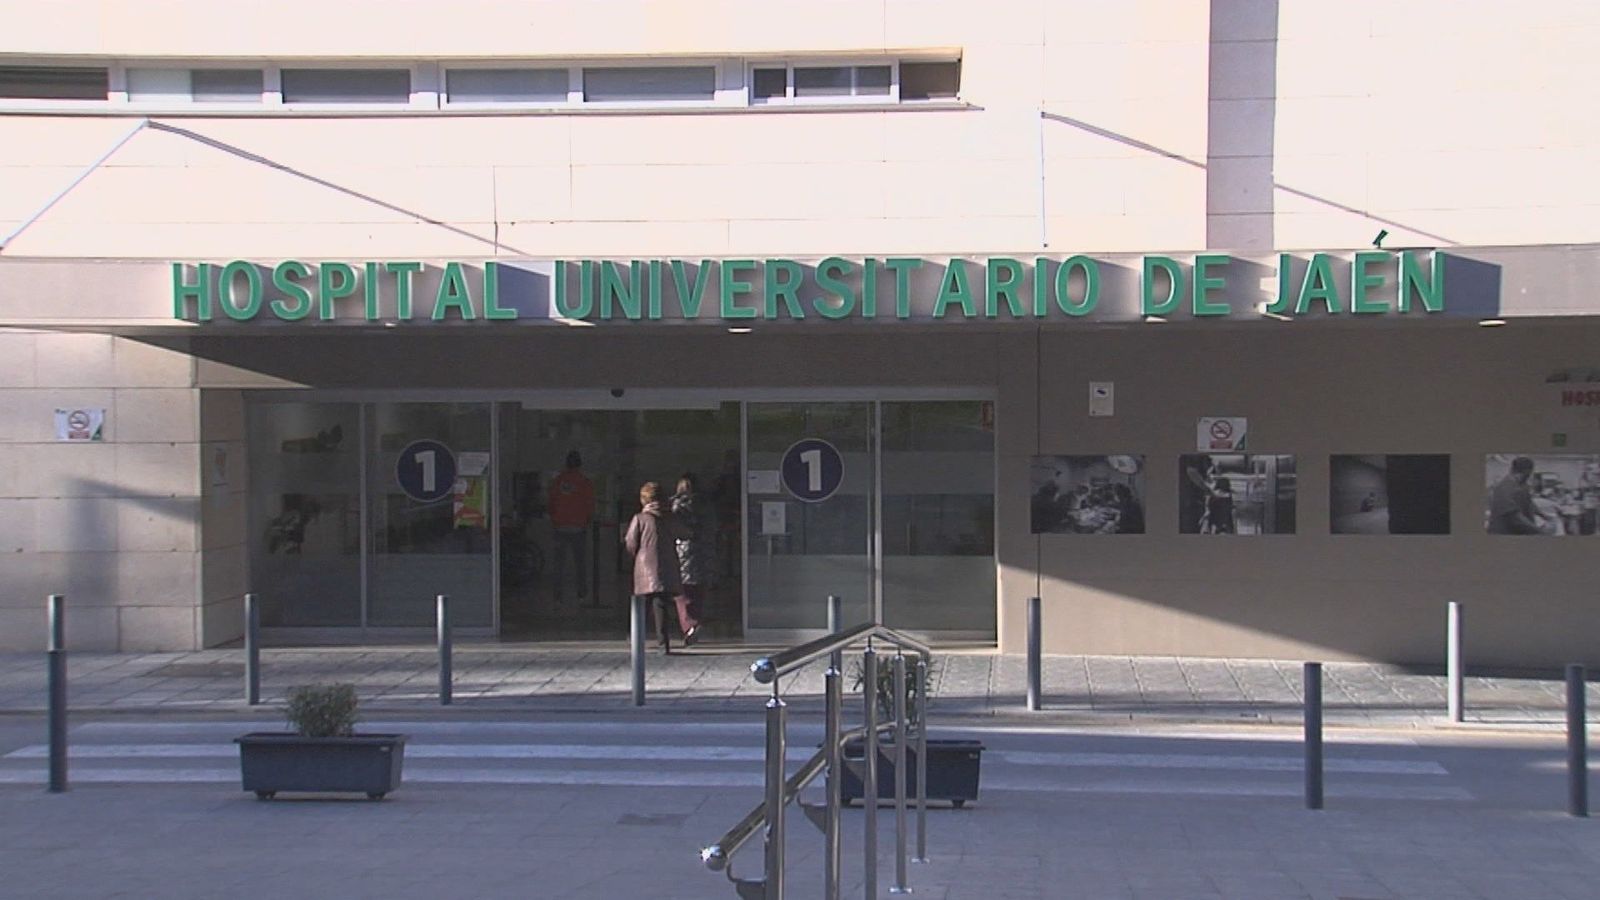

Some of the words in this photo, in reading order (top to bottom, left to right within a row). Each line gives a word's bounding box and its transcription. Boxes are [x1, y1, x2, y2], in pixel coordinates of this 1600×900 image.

[172, 261, 518, 321] HOSPITAL
[553, 257, 1099, 319] UNIVERSITARIO
[1142, 255, 1230, 316] DE
[1264, 230, 1445, 315] JAÉN
[414, 450, 436, 492] 1
[799, 450, 822, 492] 1
